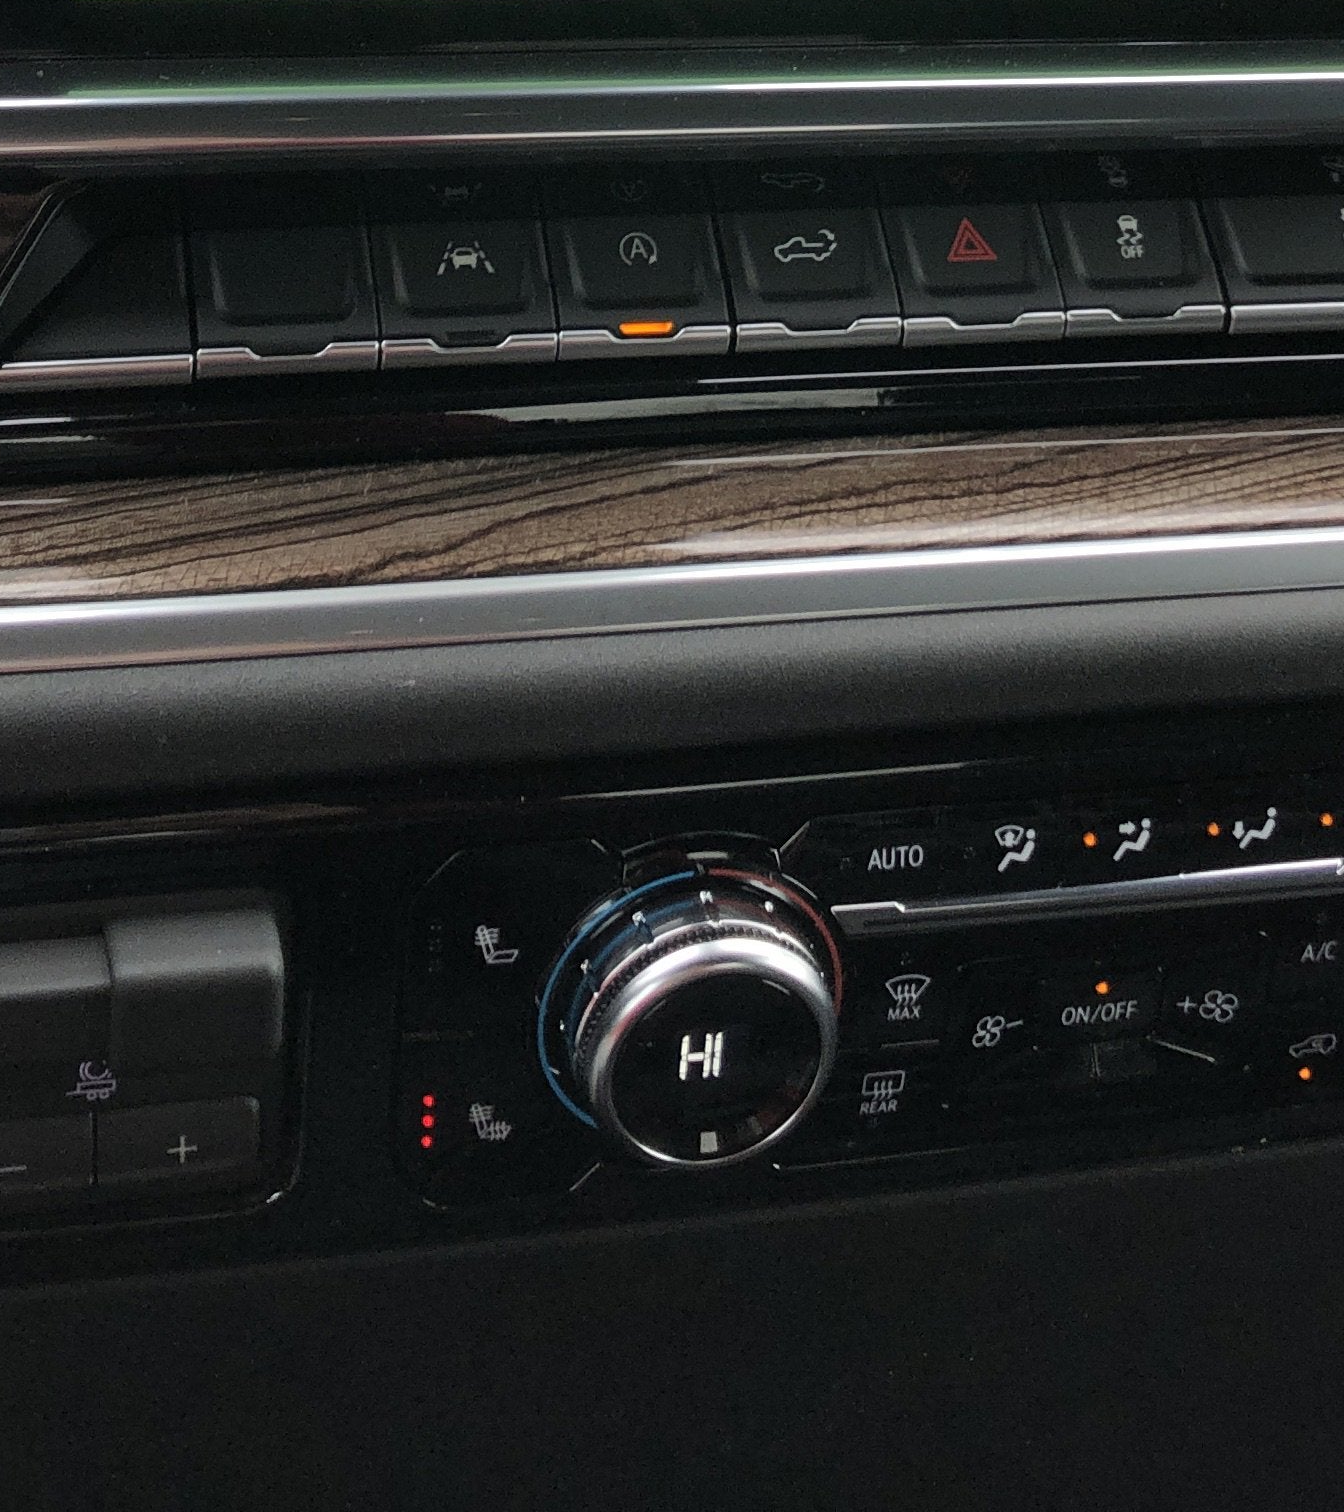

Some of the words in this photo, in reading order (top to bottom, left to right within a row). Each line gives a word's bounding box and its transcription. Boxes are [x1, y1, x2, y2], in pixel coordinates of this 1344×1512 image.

[1121, 245, 1144, 258] OFF
[868, 845, 924, 870] AUTO
[1302, 941, 1337, 962] A/C
[888, 1005, 921, 1020] MAX
[1061, 1000, 1138, 1026] ON/OFF
[679, 1032, 724, 1079] HI
[860, 1098, 898, 1115] REAR
